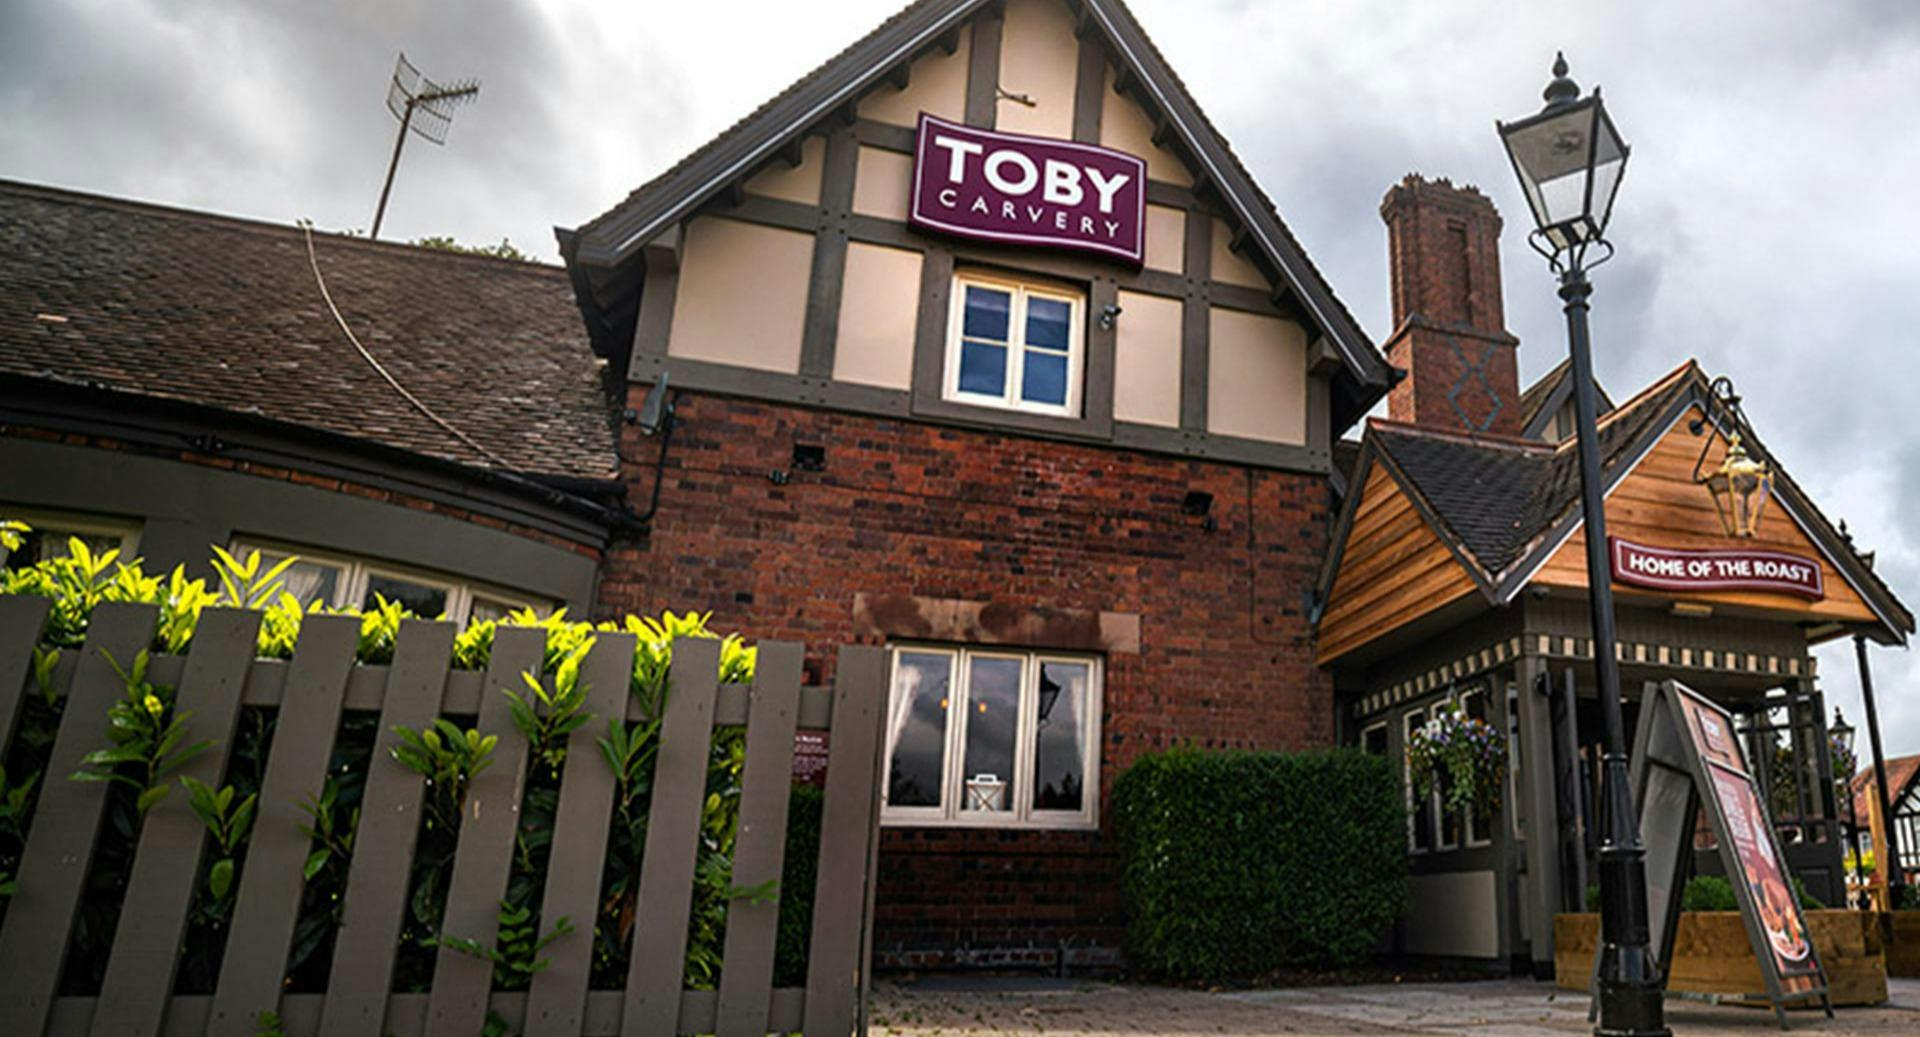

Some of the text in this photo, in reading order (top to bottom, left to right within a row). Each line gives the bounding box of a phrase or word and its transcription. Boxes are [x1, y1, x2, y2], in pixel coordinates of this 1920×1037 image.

[935, 136, 1130, 213] TOBY
[939, 189, 1119, 237] CARVERY
[1629, 553, 1811, 582] HOME OF THE ROAST
